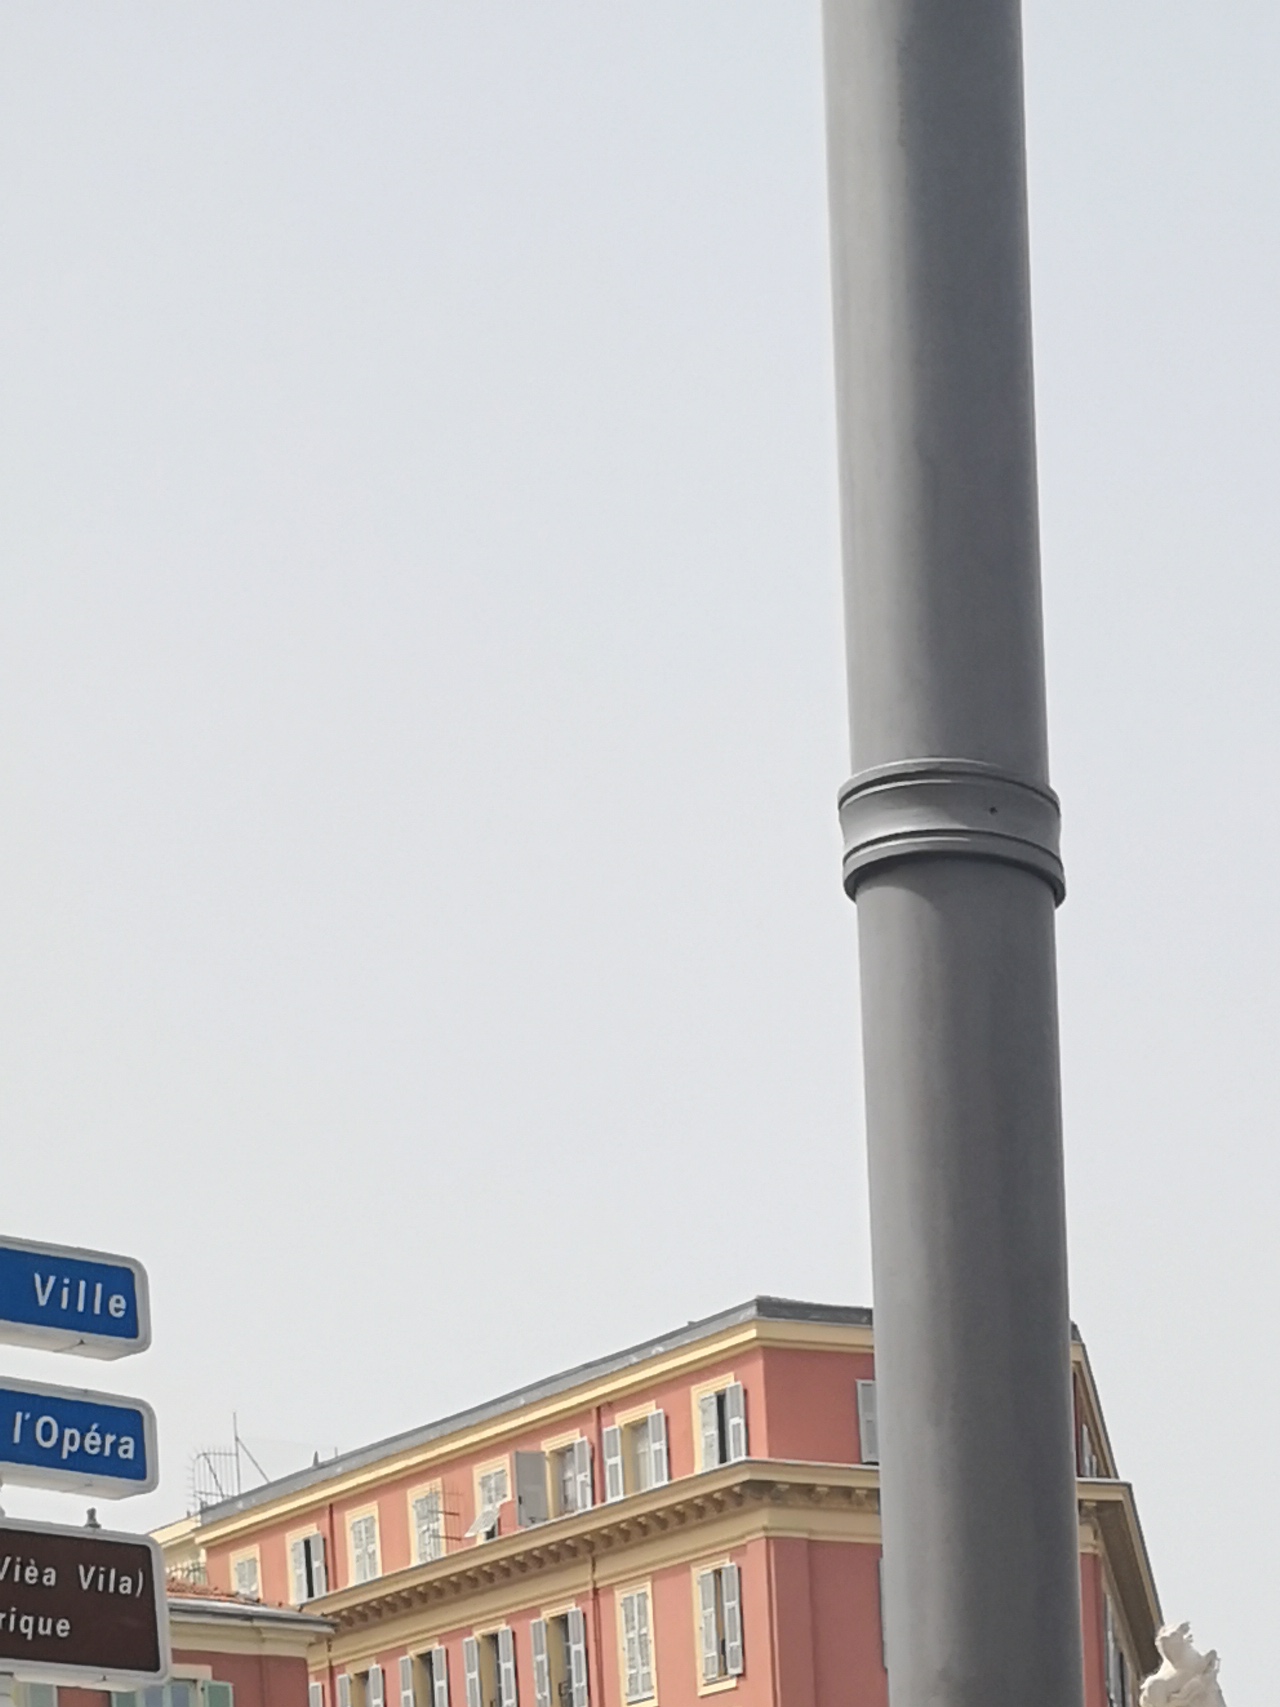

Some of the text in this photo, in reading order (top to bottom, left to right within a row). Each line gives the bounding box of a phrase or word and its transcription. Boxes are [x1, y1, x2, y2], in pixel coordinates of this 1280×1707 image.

[34, 1273, 127, 1318] Ville
[13, 1411, 135, 1460] l'Opéra
[78, 1564, 144, 1598] Vila)
